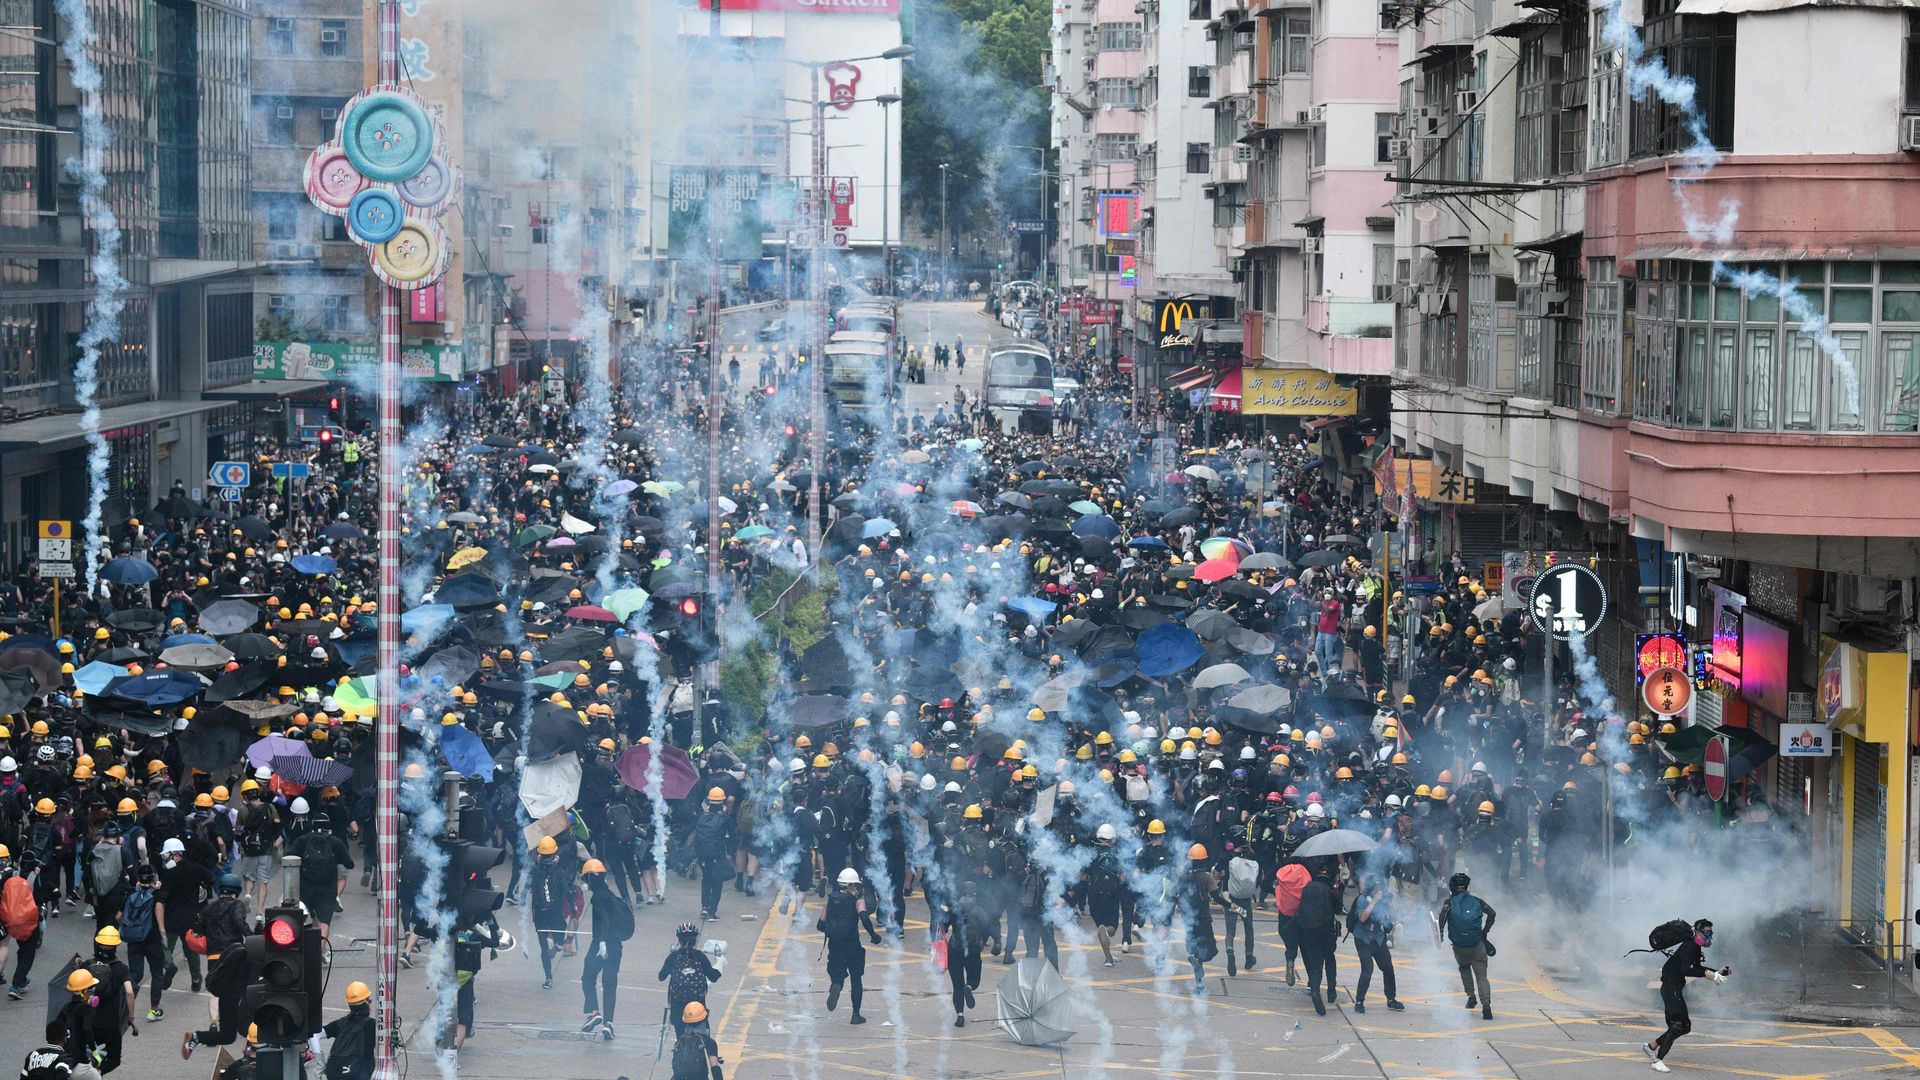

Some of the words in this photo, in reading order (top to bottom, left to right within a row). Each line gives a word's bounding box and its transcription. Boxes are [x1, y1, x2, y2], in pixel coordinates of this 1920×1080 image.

[673, 173, 706, 187] SHAM
[725, 173, 758, 187] SHAM
[673, 187, 706, 200] SHUI
[725, 187, 758, 200] SHUI
[672, 200, 689, 212] PO
[725, 200, 742, 212] PO
[1291, 394, 1348, 407] Colonie
[230, 491, 237, 499] P
[60, 540, 65, 548] 7
[60, 551, 65, 559] 7
[1662, 672, 1673, 710] 位元堂
